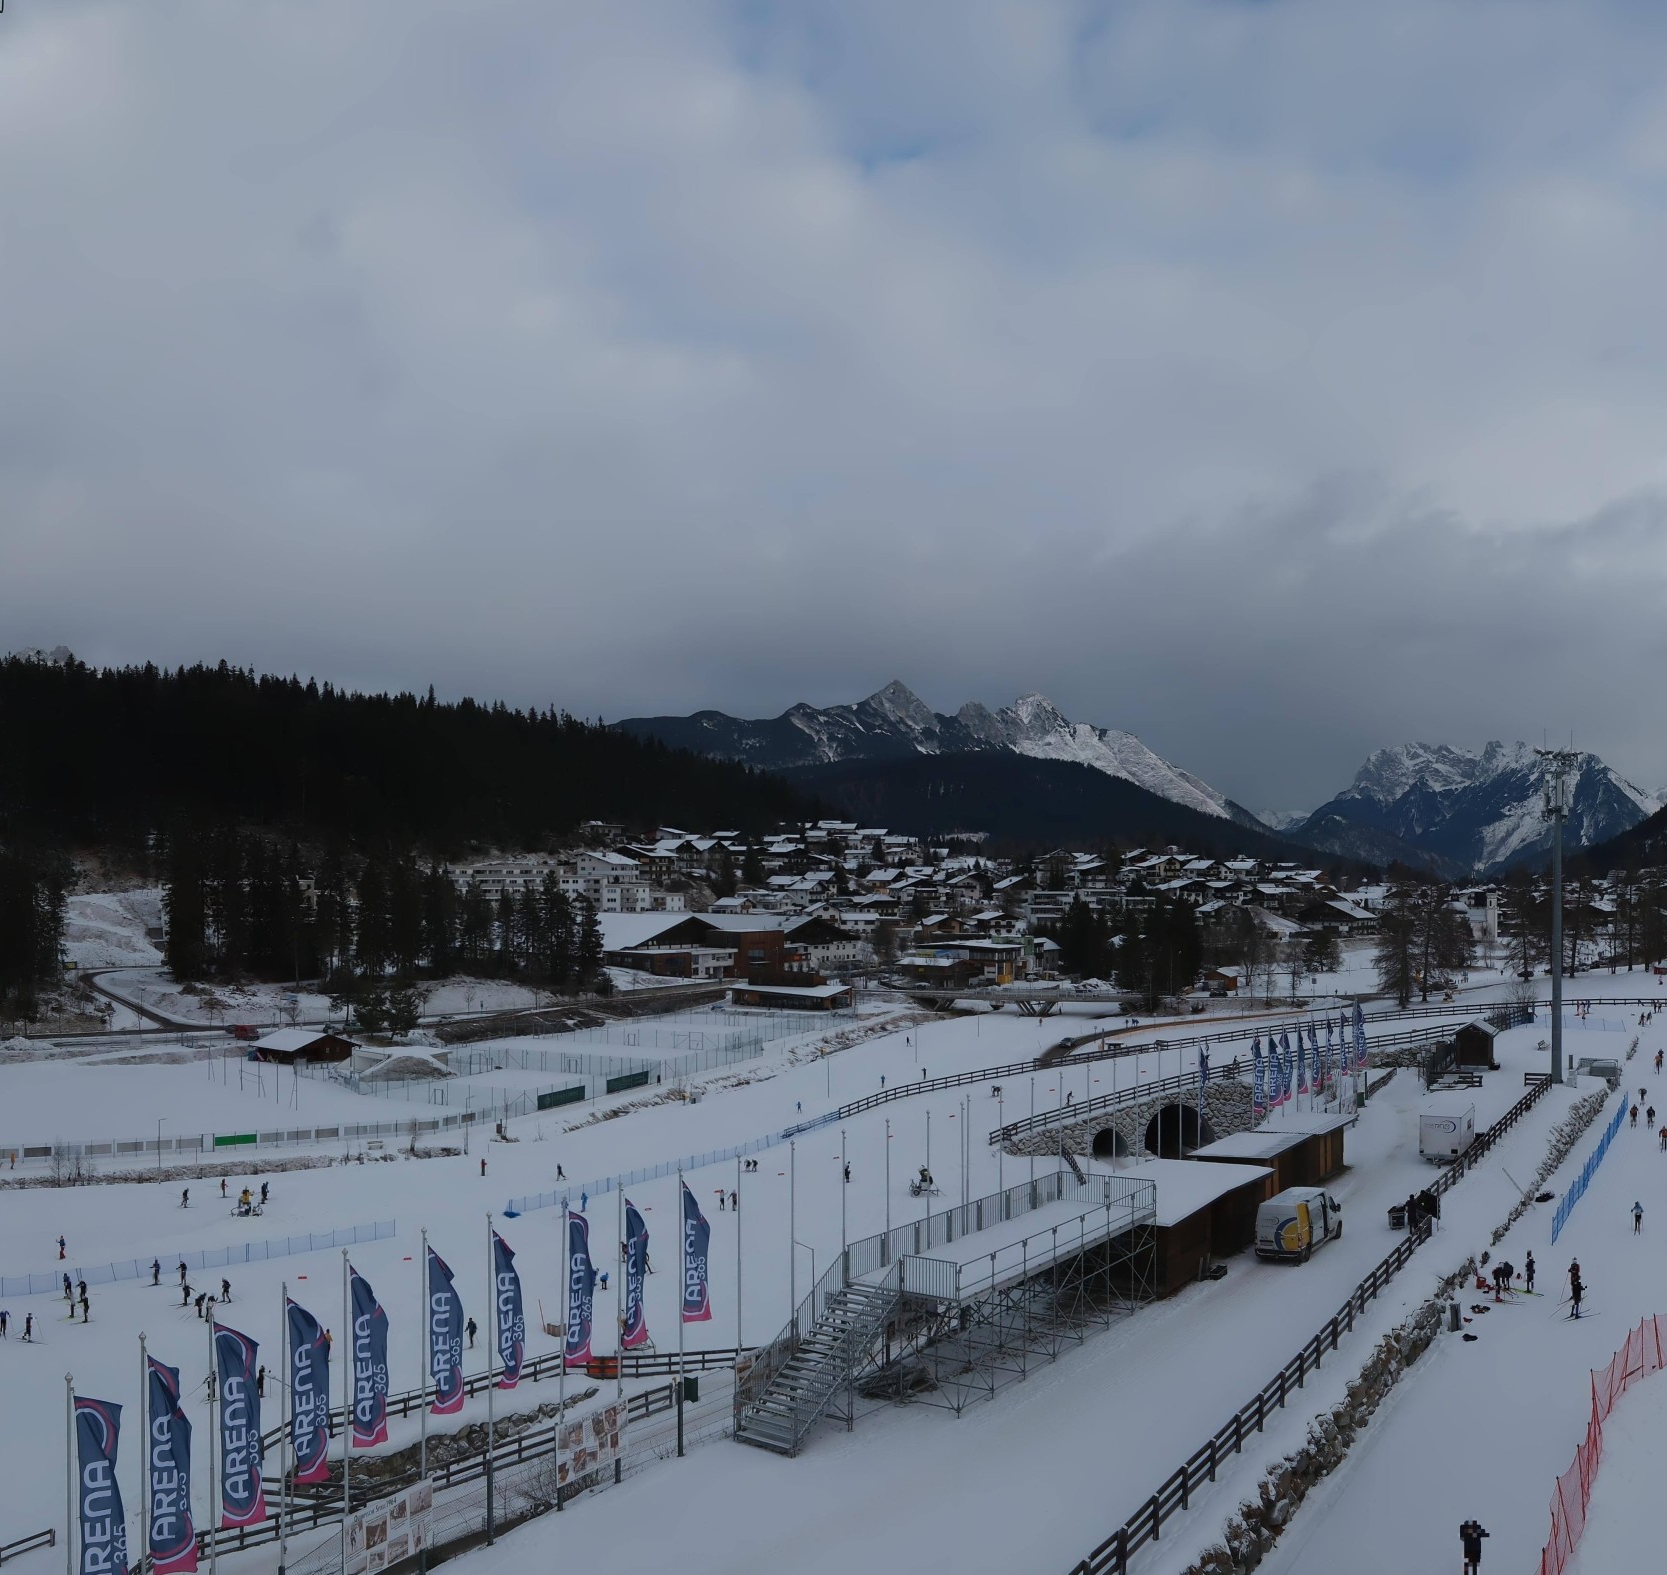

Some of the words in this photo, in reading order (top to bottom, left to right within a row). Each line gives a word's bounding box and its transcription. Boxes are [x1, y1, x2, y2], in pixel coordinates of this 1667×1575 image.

[1269, 1053, 1278, 1096] ARENA
[431, 1291, 452, 1391] ARENA
[497, 1272, 515, 1368] ARENA
[513, 1314, 524, 1342] 365
[568, 1252, 586, 1344] ARENA
[581, 1296, 593, 1321] 365
[354, 1313, 375, 1422] ARENA
[374, 1363, 386, 1394] 365
[450, 1337, 461, 1366] 365
[223, 1376, 250, 1500] ARENA
[293, 1343, 315, 1457] ARENA
[315, 1393, 327, 1427] 365
[83, 1459, 113, 1575] RENA
[151, 1412, 179, 1542] ARENA
